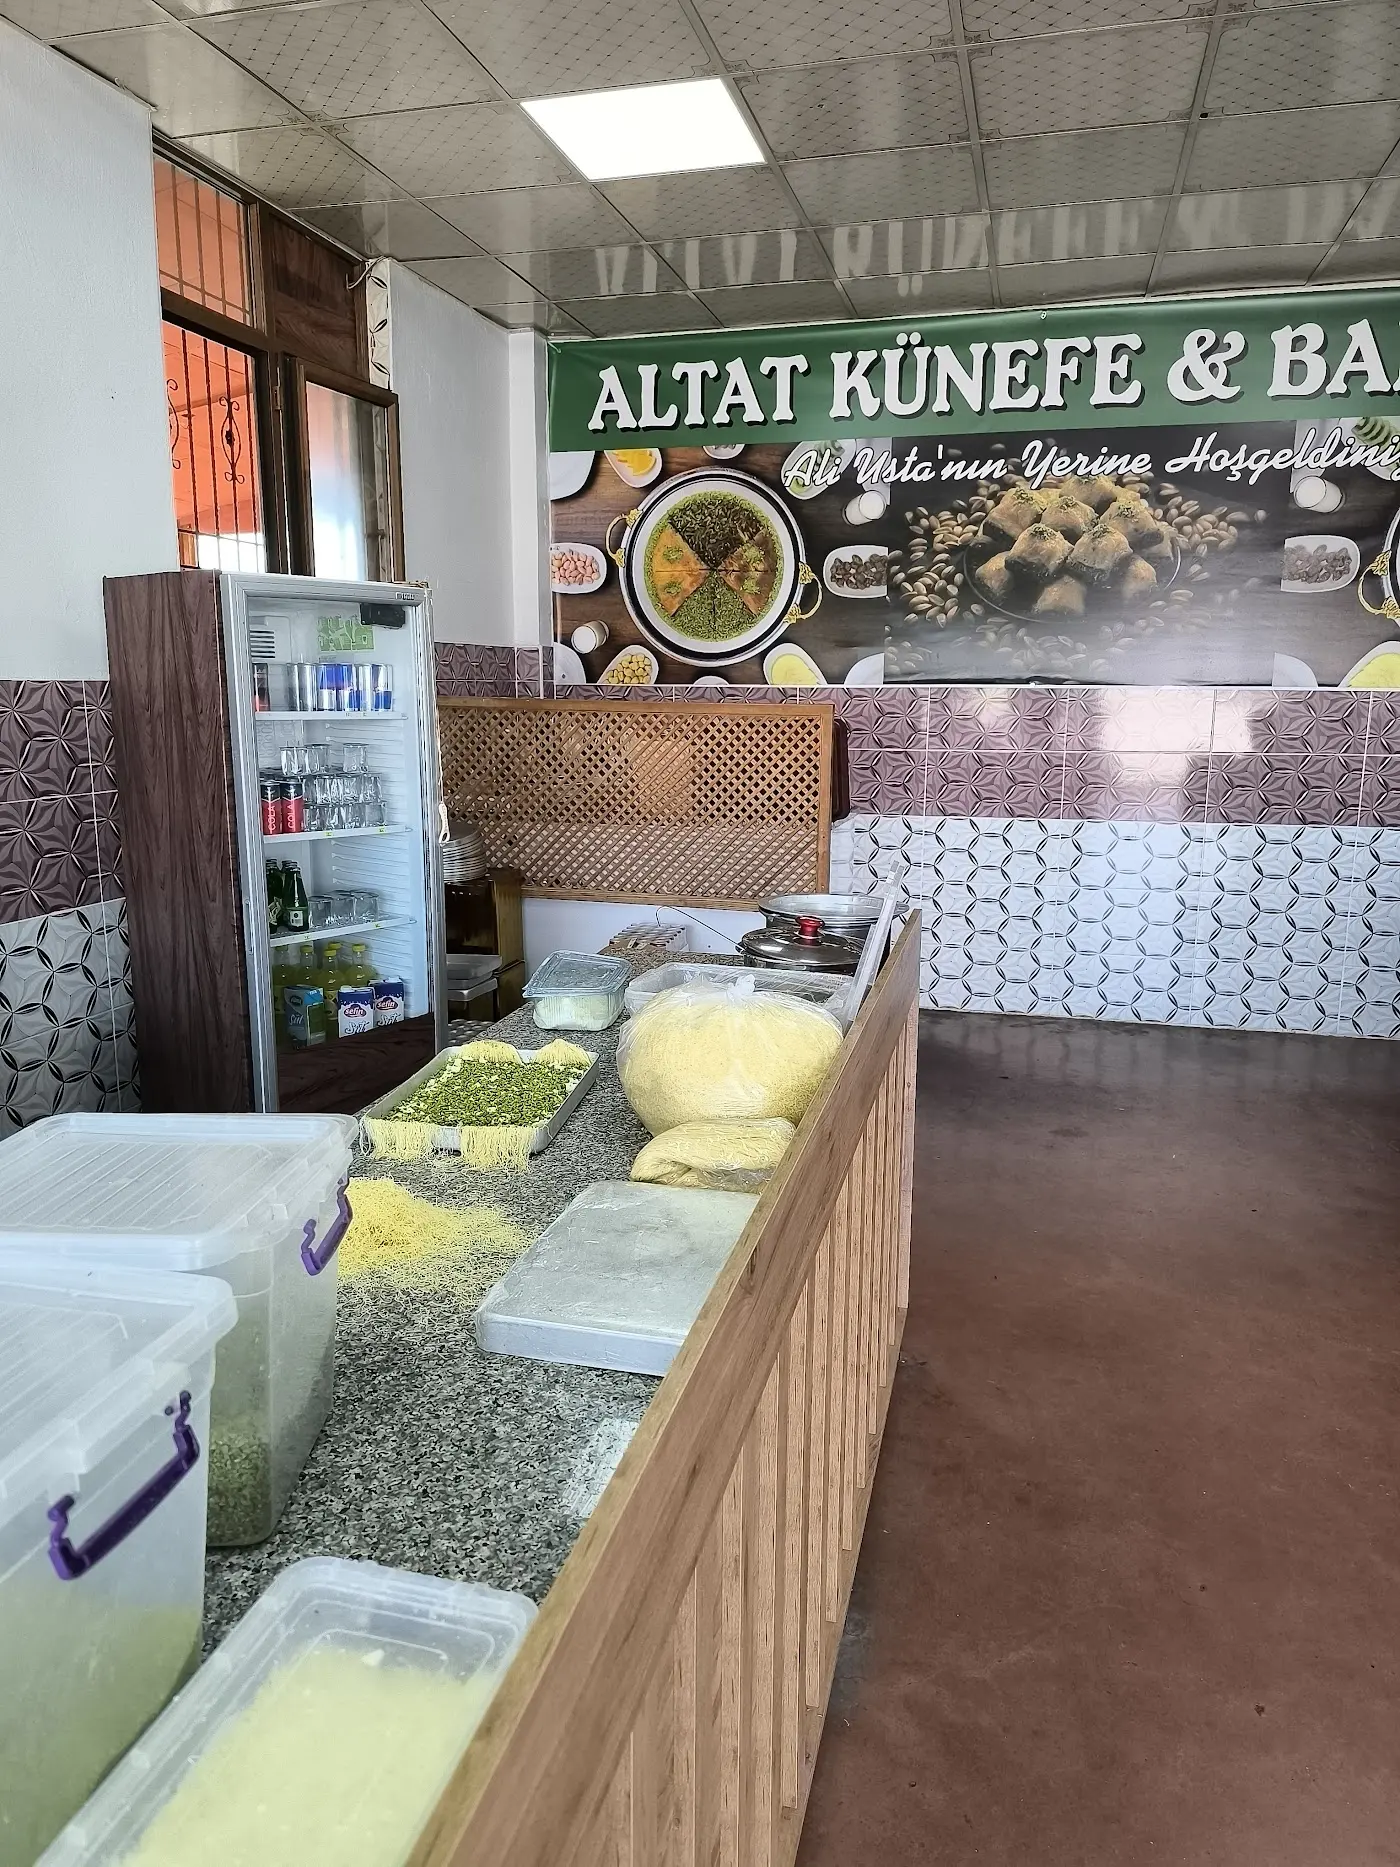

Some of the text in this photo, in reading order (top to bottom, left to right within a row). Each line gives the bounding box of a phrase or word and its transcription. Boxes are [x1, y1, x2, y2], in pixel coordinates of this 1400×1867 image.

[588, 318, 1400, 431] ALTAT KÜNEFE & BA
[784, 449, 842, 487] Ali
[853, 443, 1008, 485] Usta'nın
[1021, 439, 1152, 490] Yerine
[267, 805, 276, 831] COLA
[287, 804, 296, 829] COLA
